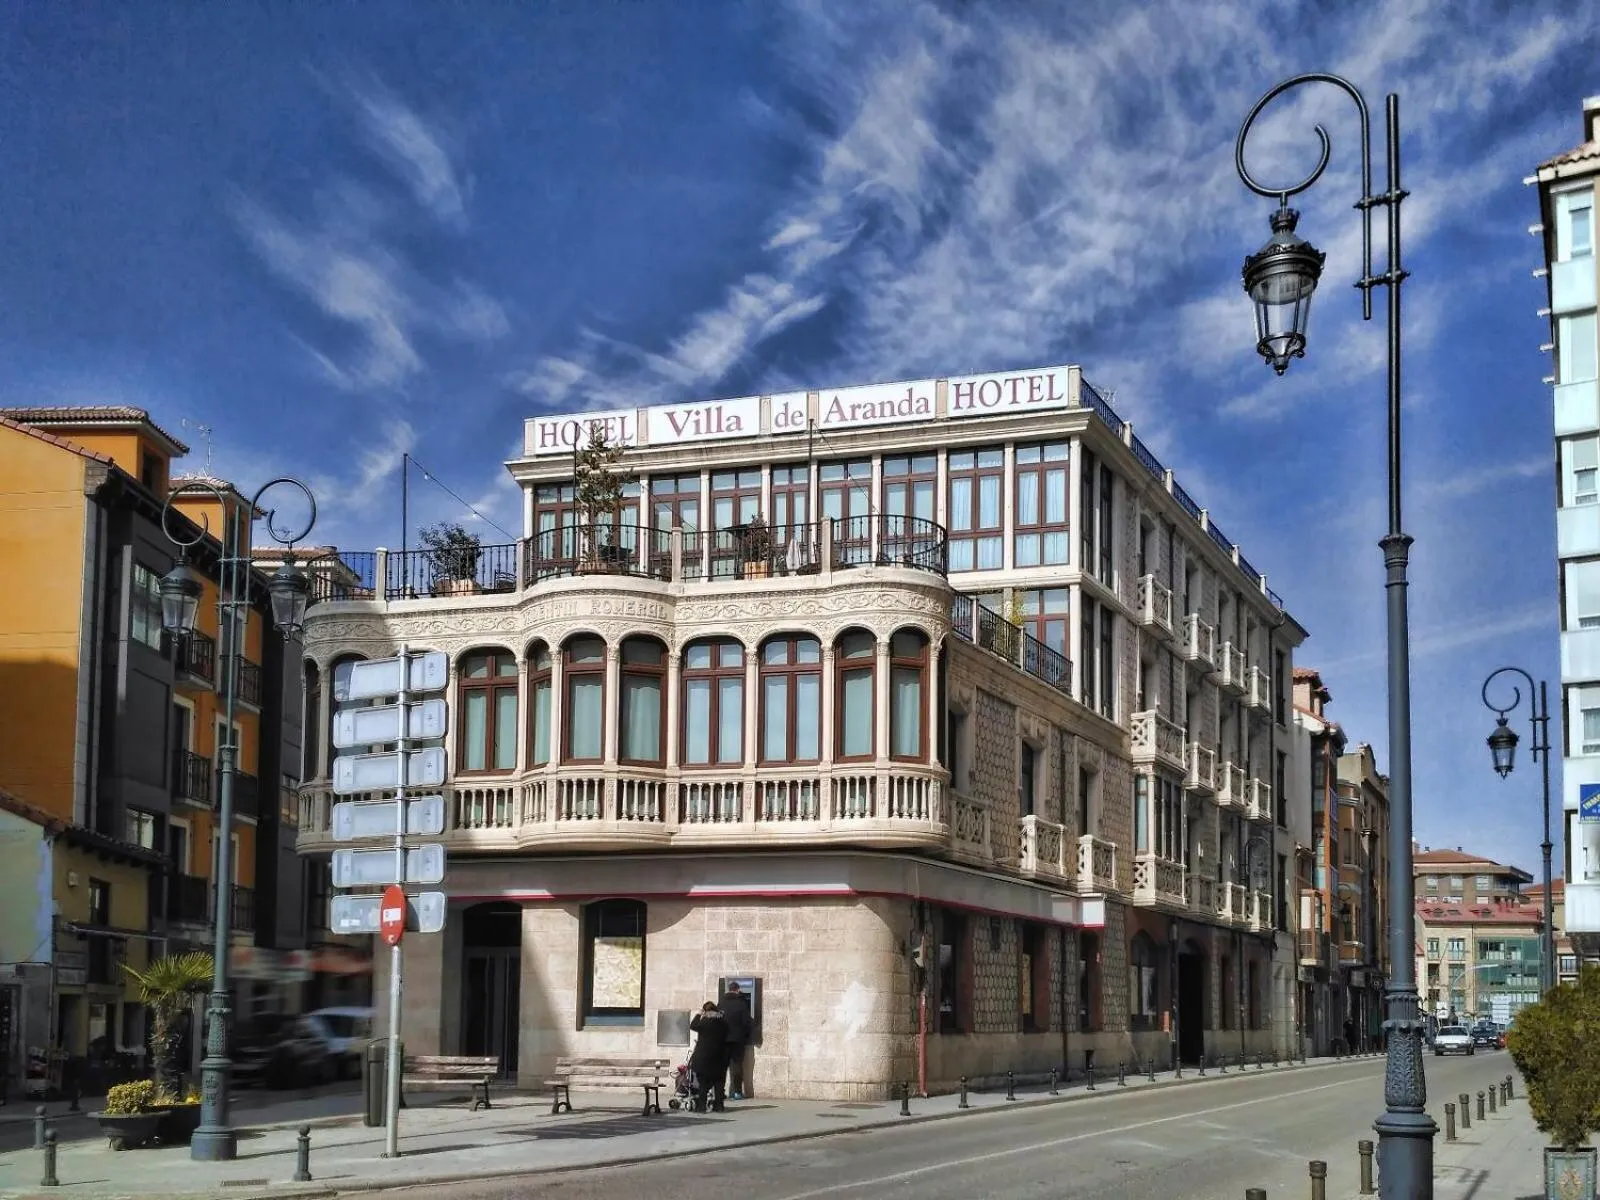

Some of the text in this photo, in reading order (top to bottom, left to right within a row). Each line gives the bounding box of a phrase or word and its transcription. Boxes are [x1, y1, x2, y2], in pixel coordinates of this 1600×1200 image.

[540, 374, 1065, 448] HOTEL Villa de Aranda HOTEL
